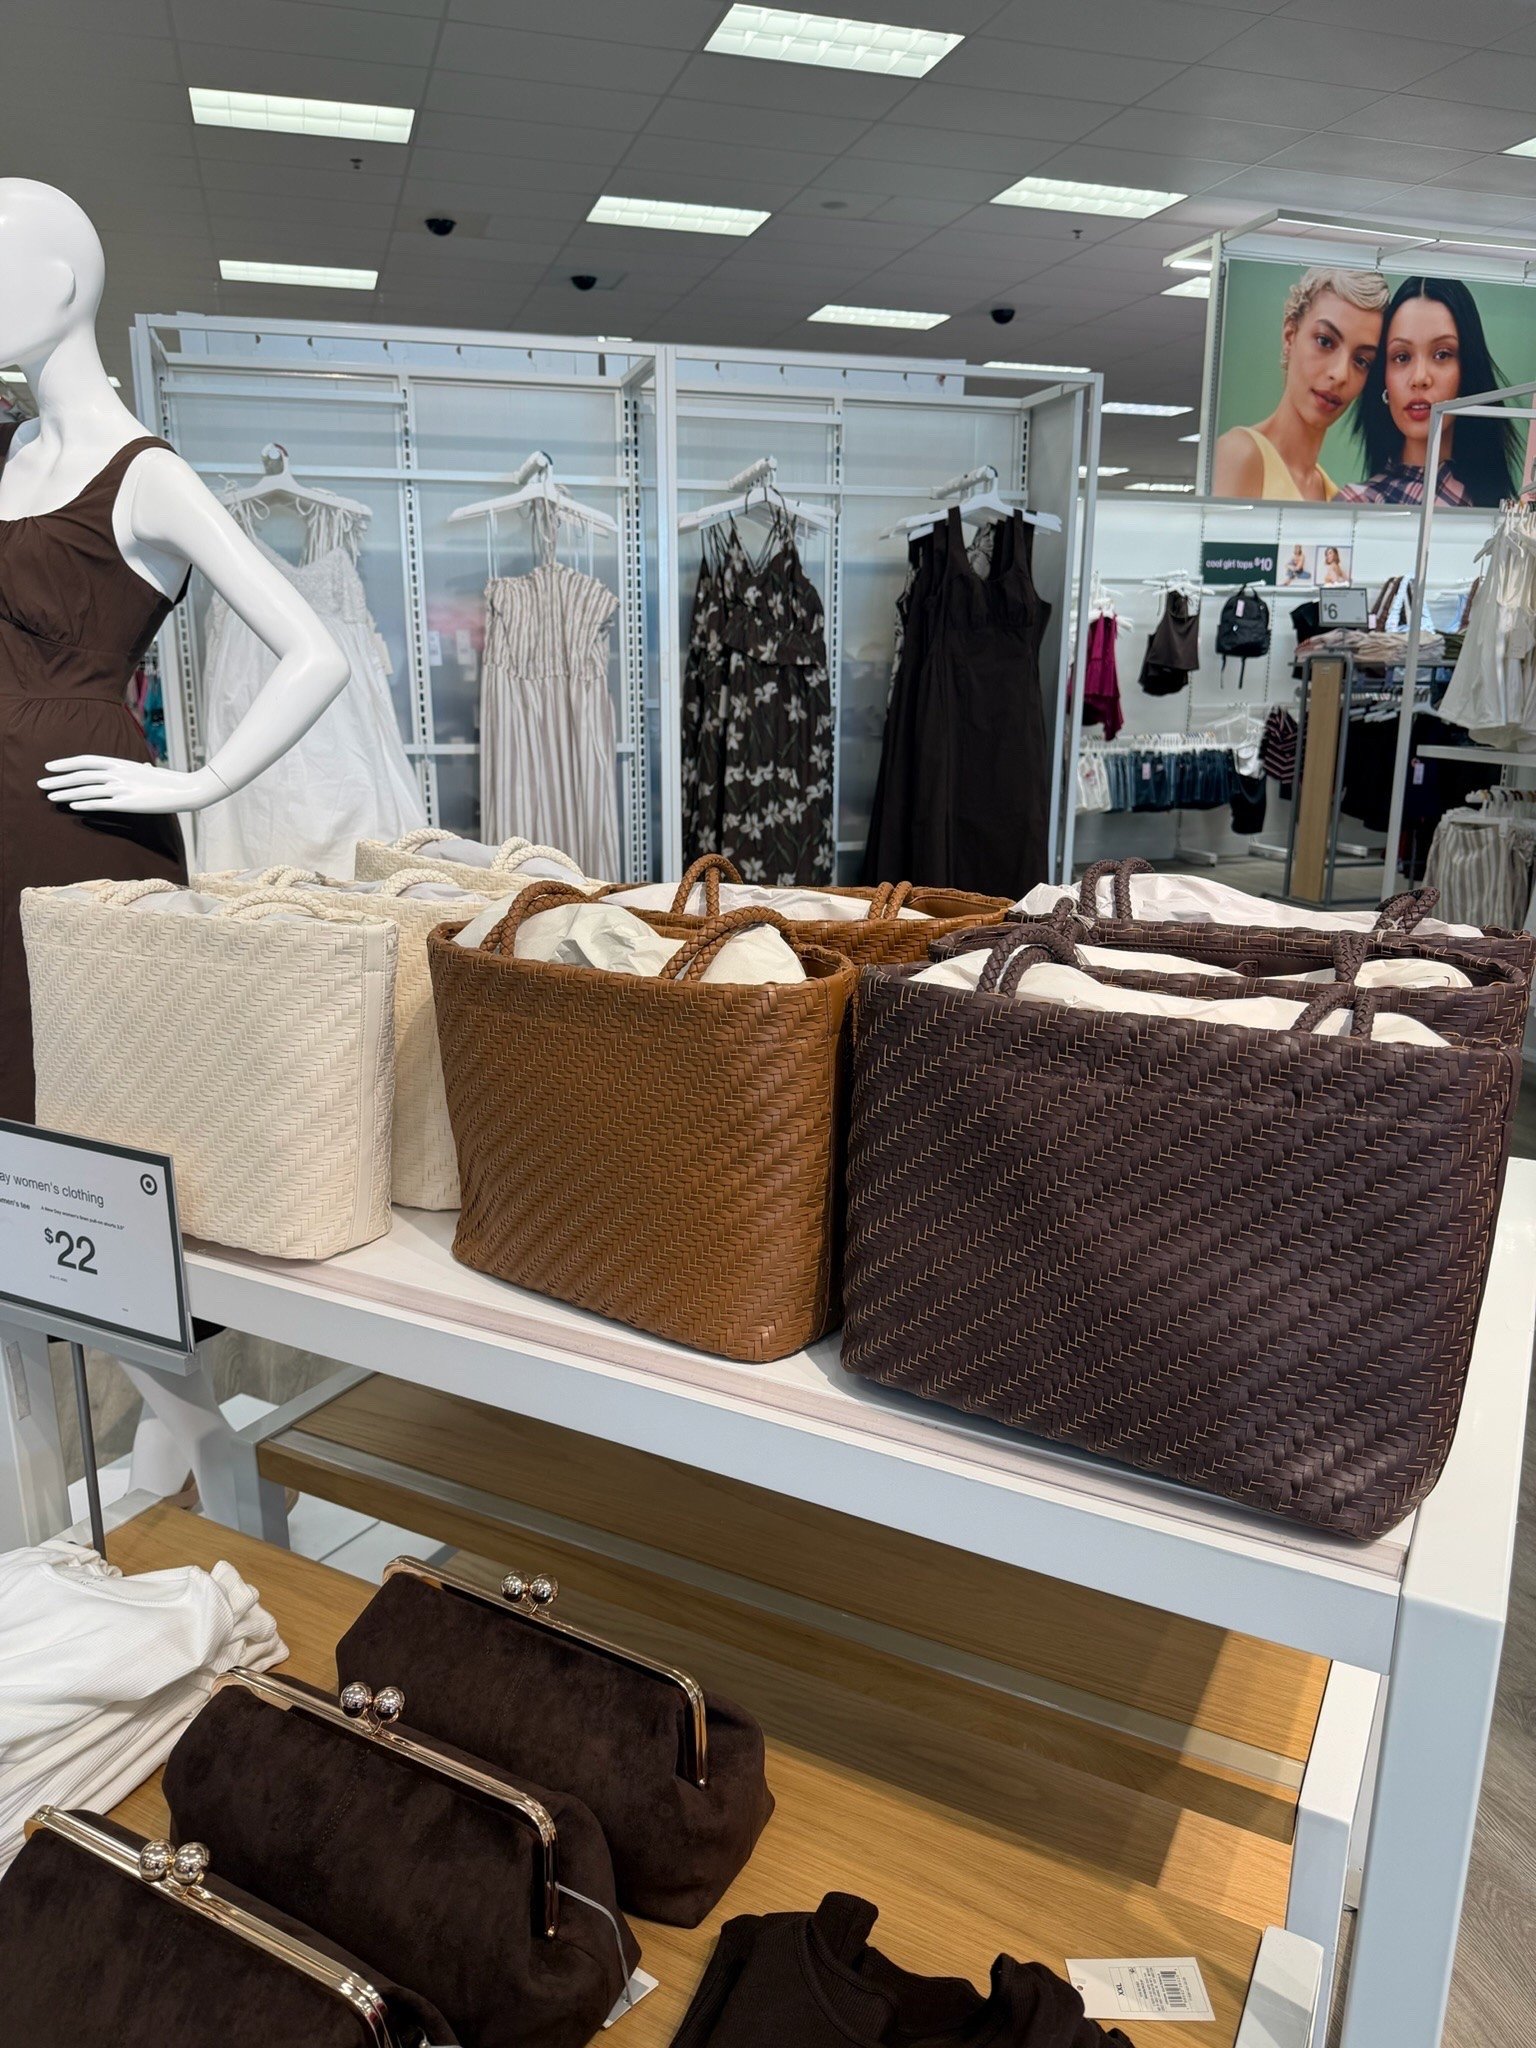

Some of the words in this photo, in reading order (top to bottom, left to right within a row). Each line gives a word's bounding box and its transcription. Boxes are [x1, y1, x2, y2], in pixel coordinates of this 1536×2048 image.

[1206, 559, 1222, 568] cool
[1223, 558, 1235, 570] girl
[1236, 559, 1253, 570] tops
[1254, 557, 1273, 571] $10
[13, 1175, 60, 1195] women's
[62, 1186, 104, 1208] clothing
[44, 1227, 98, 1275] $22
